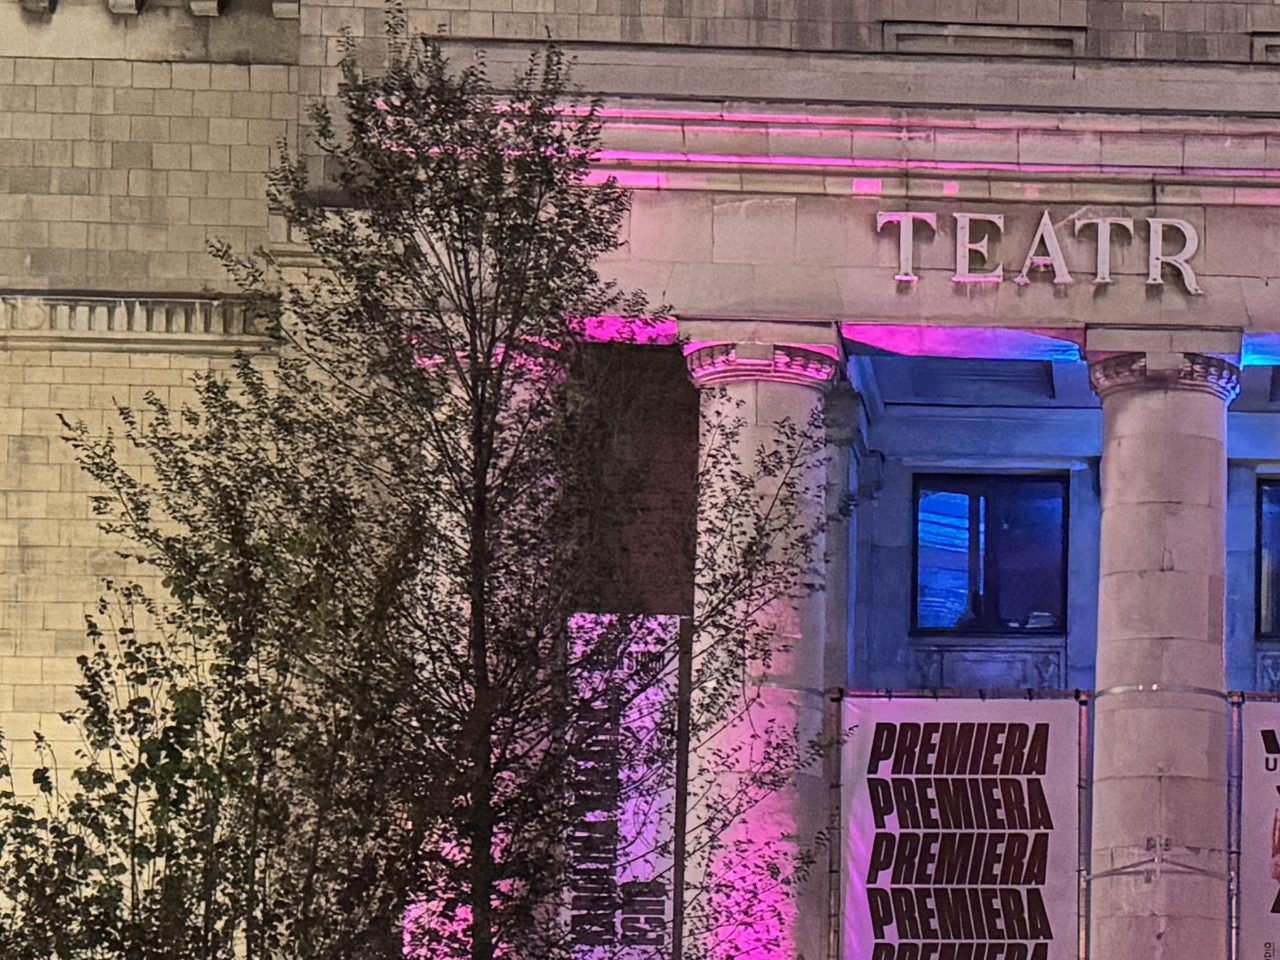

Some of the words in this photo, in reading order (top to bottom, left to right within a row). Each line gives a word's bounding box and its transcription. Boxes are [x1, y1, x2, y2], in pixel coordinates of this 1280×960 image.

[876, 210, 1205, 296] TEATR
[867, 722, 1049, 775] PREMIERA
[1265, 756, 1278, 772] U
[866, 778, 1054, 830] PREMIERA
[866, 832, 1049, 885] PREMIERA
[866, 887, 1054, 940] PREMIERA
